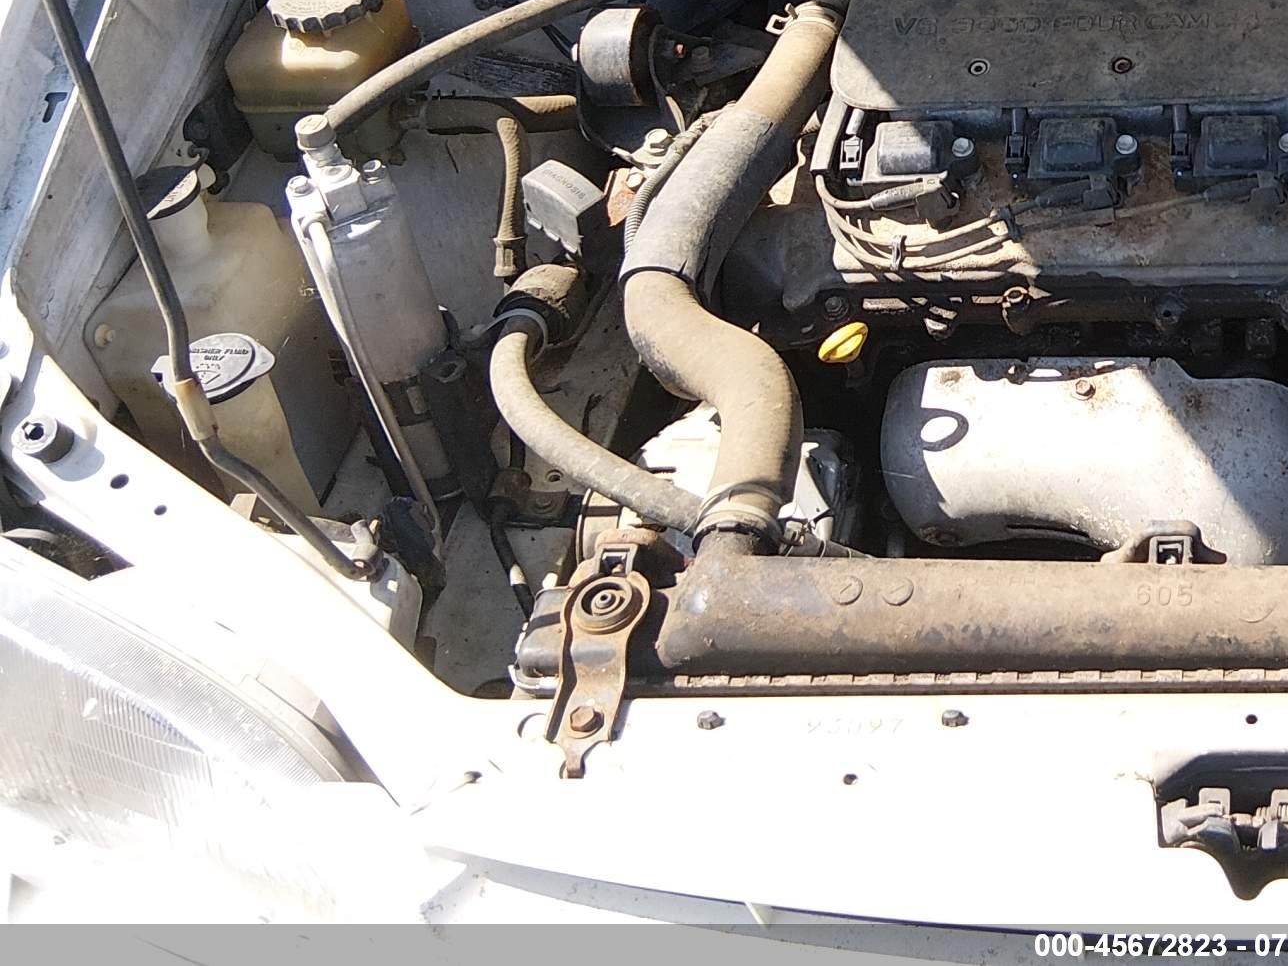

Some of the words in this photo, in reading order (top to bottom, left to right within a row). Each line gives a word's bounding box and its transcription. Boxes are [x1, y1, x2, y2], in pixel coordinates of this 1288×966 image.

[1052, 14, 1138, 34] FOUR
[1144, 13, 1211, 32] CAM
[1136, 582, 1193, 607] 605
